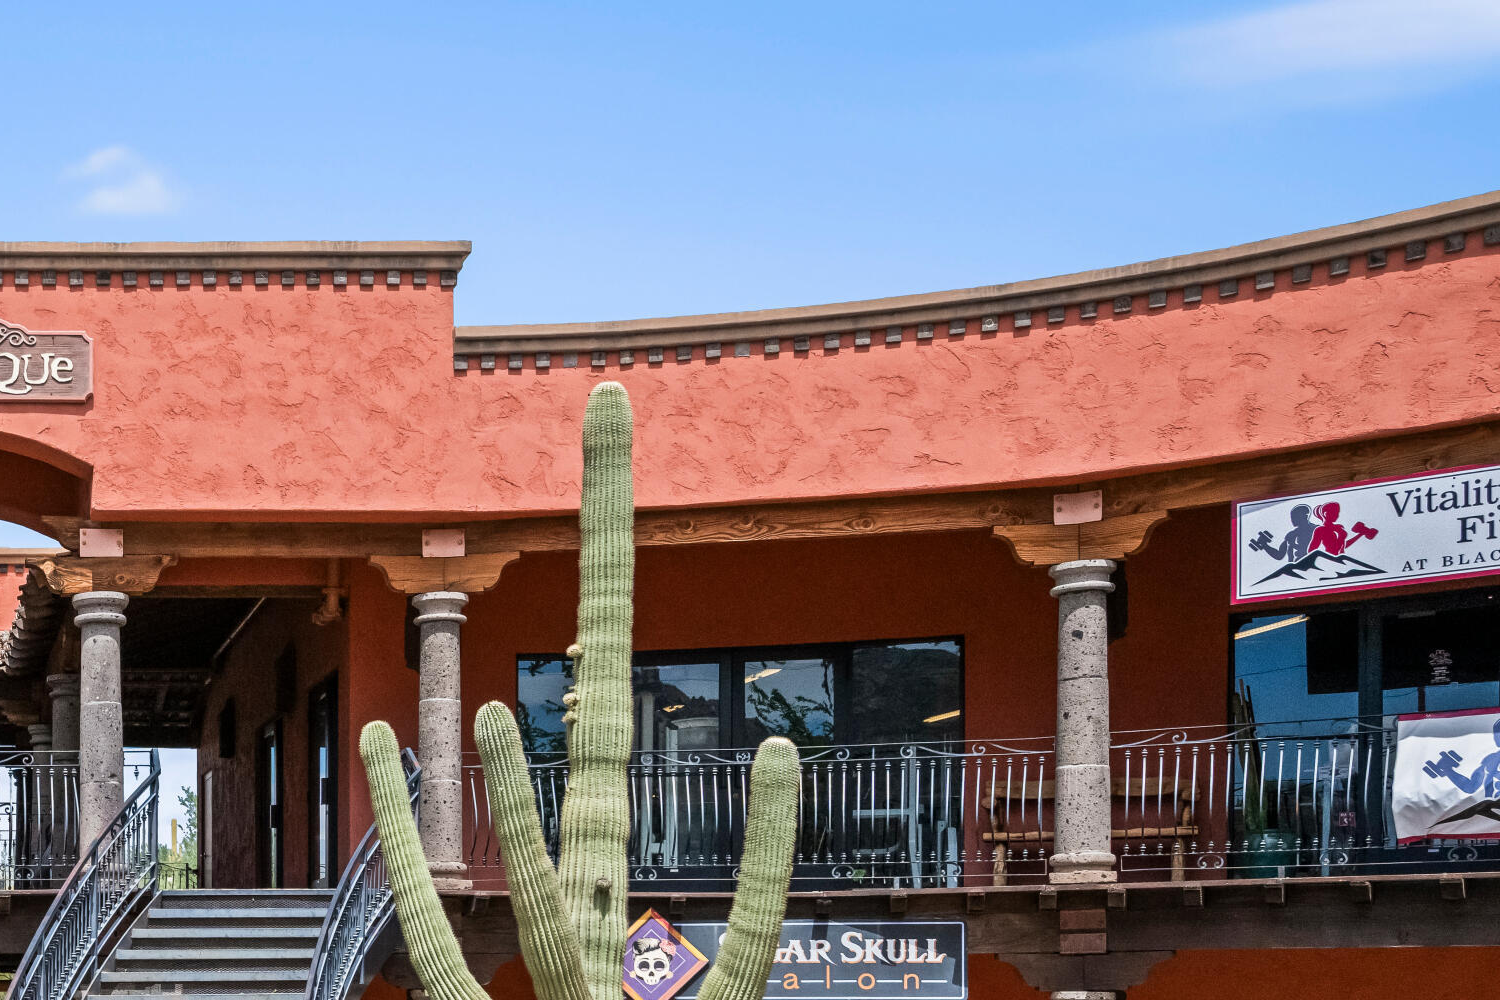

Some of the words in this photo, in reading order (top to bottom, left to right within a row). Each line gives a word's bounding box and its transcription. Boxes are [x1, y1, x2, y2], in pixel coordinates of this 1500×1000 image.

[1386, 478, 1500, 518] Vitalit
[1456, 512, 1500, 544] Fi
[1402, 559, 1428, 572] AT
[840, 931, 947, 966] SKULL
[783, 964, 920, 990] alon
